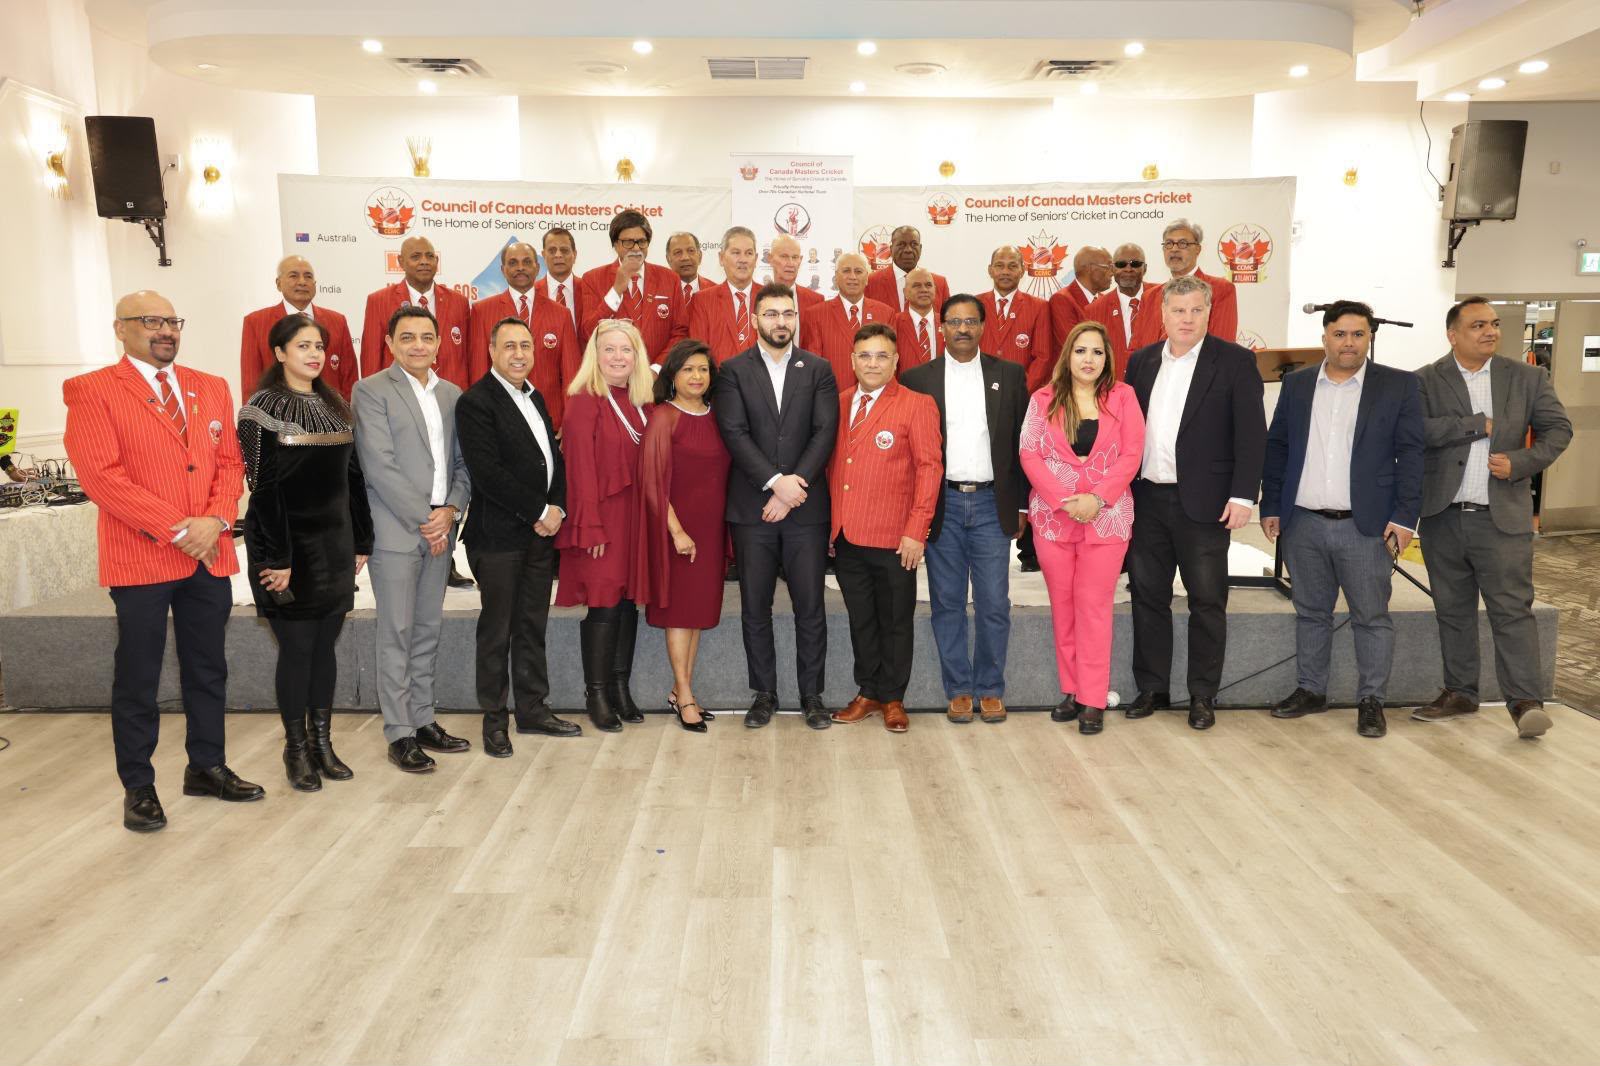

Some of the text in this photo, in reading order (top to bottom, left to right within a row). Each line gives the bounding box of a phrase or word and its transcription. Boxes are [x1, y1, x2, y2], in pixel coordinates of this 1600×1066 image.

[964, 191, 1192, 208] Council of Canada Masters Cricket
[421, 199, 476, 213] Council
[479, 201, 494, 213] of
[495, 202, 553, 215] Canada
[555, 203, 612, 216] Masters
[964, 213, 984, 223] The
[985, 212, 1017, 222] Home
[1018, 212, 1029, 222] of
[1070, 210, 1106, 220] Cricket
[1108, 210, 1118, 220] in
[1120, 209, 1164, 219] Canada
[422, 217, 442, 228] The
[445, 218, 479, 229] Home
[481, 218, 494, 229] of
[578, 220, 588, 231] in
[317, 233, 357, 243] Australia
[1234, 273, 1257, 282] ATLANTIC
[319, 284, 342, 294] India
